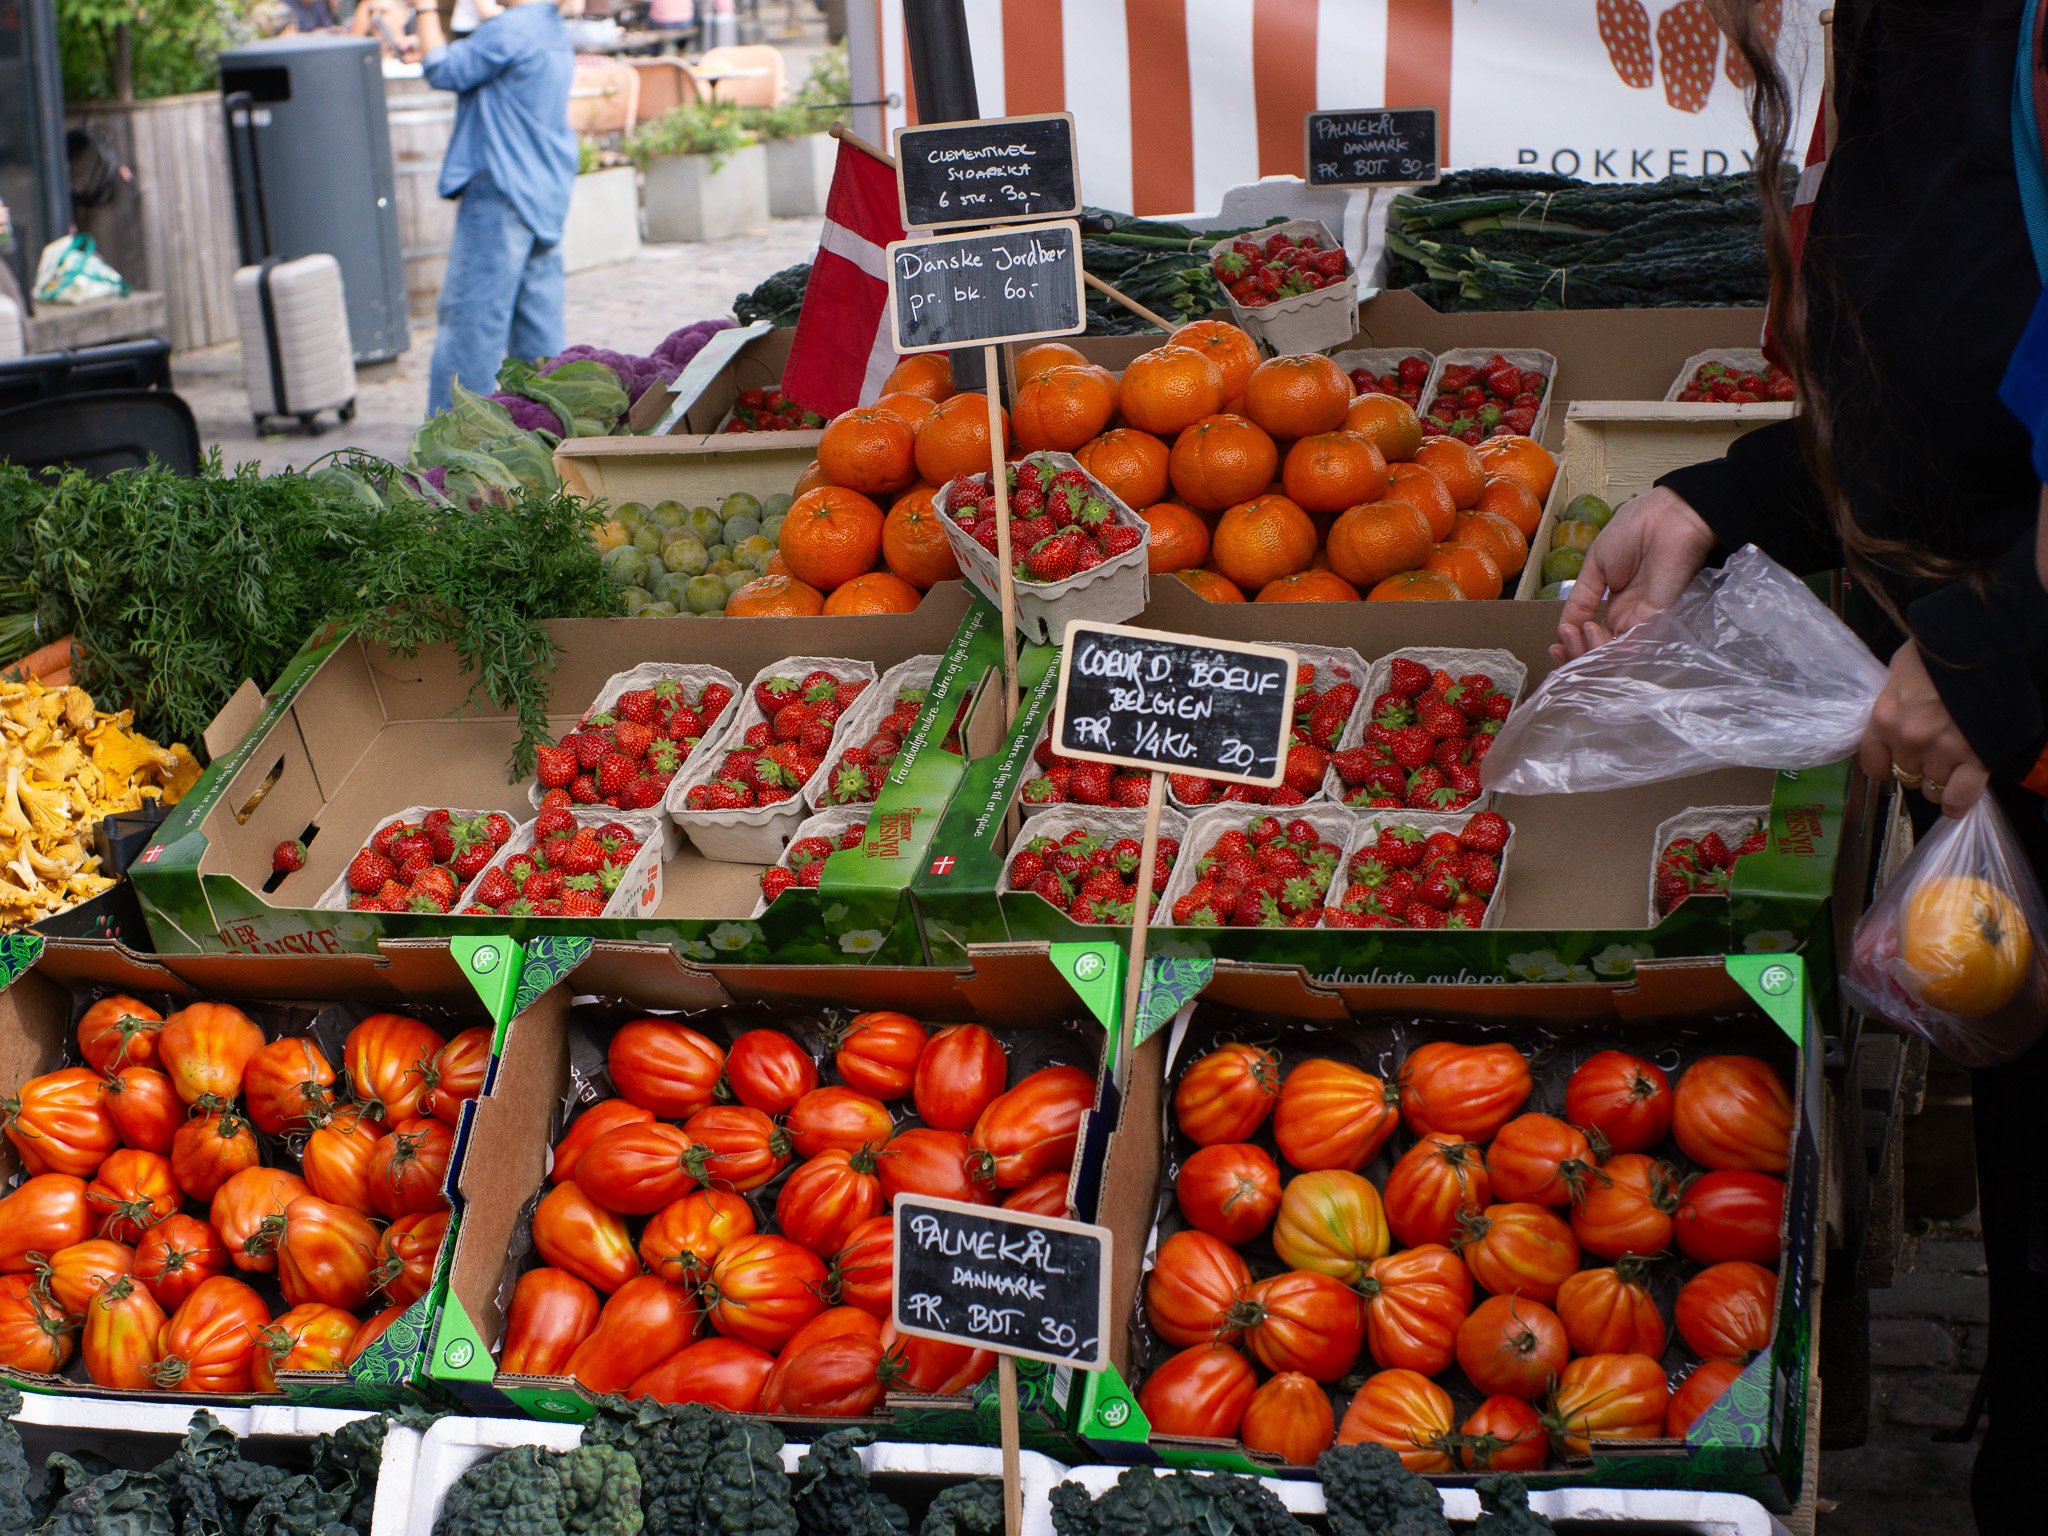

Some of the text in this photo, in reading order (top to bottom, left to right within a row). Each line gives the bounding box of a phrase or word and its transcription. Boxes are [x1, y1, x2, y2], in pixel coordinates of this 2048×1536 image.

[1316, 113, 1402, 139] PALMEKÅL
[1343, 138, 1409, 155] DANMARK
[1318, 162, 1343, 179] PR.
[939, 191, 950, 208] 6
[896, 239, 1066, 280] Danske Jordbær
[910, 292, 942, 322] pr.
[954, 286, 986, 302] bk.
[958, 638, 970, 648] til
[965, 630, 974, 640] at
[949, 649, 969, 663] lige
[948, 663, 963, 675] og
[1187, 662, 1280, 696] BOEUF
[932, 675, 953, 699] lækre
[1034, 664, 1057, 700] udvalgte
[1022, 700, 1040, 728] avlere
[1109, 687, 1213, 720] BELGIEN
[921, 707, 939, 732] avlere
[1073, 716, 1117, 752] PR.
[903, 732, 928, 768] udvalgte
[891, 768, 909, 785] Fra
[998, 760, 1013, 771] og
[992, 773, 1012, 789] lige
[985, 801, 996, 812] at
[990, 790, 1002, 800] til
[879, 813, 900, 857] DANSKE
[1784, 809, 1816, 854] DANSKE
[232, 924, 261, 945] ER
[910, 1214, 1066, 1274] PALMEKÅL
[952, 1266, 1046, 1300] DANMARK
[907, 1293, 950, 1331] PR.
